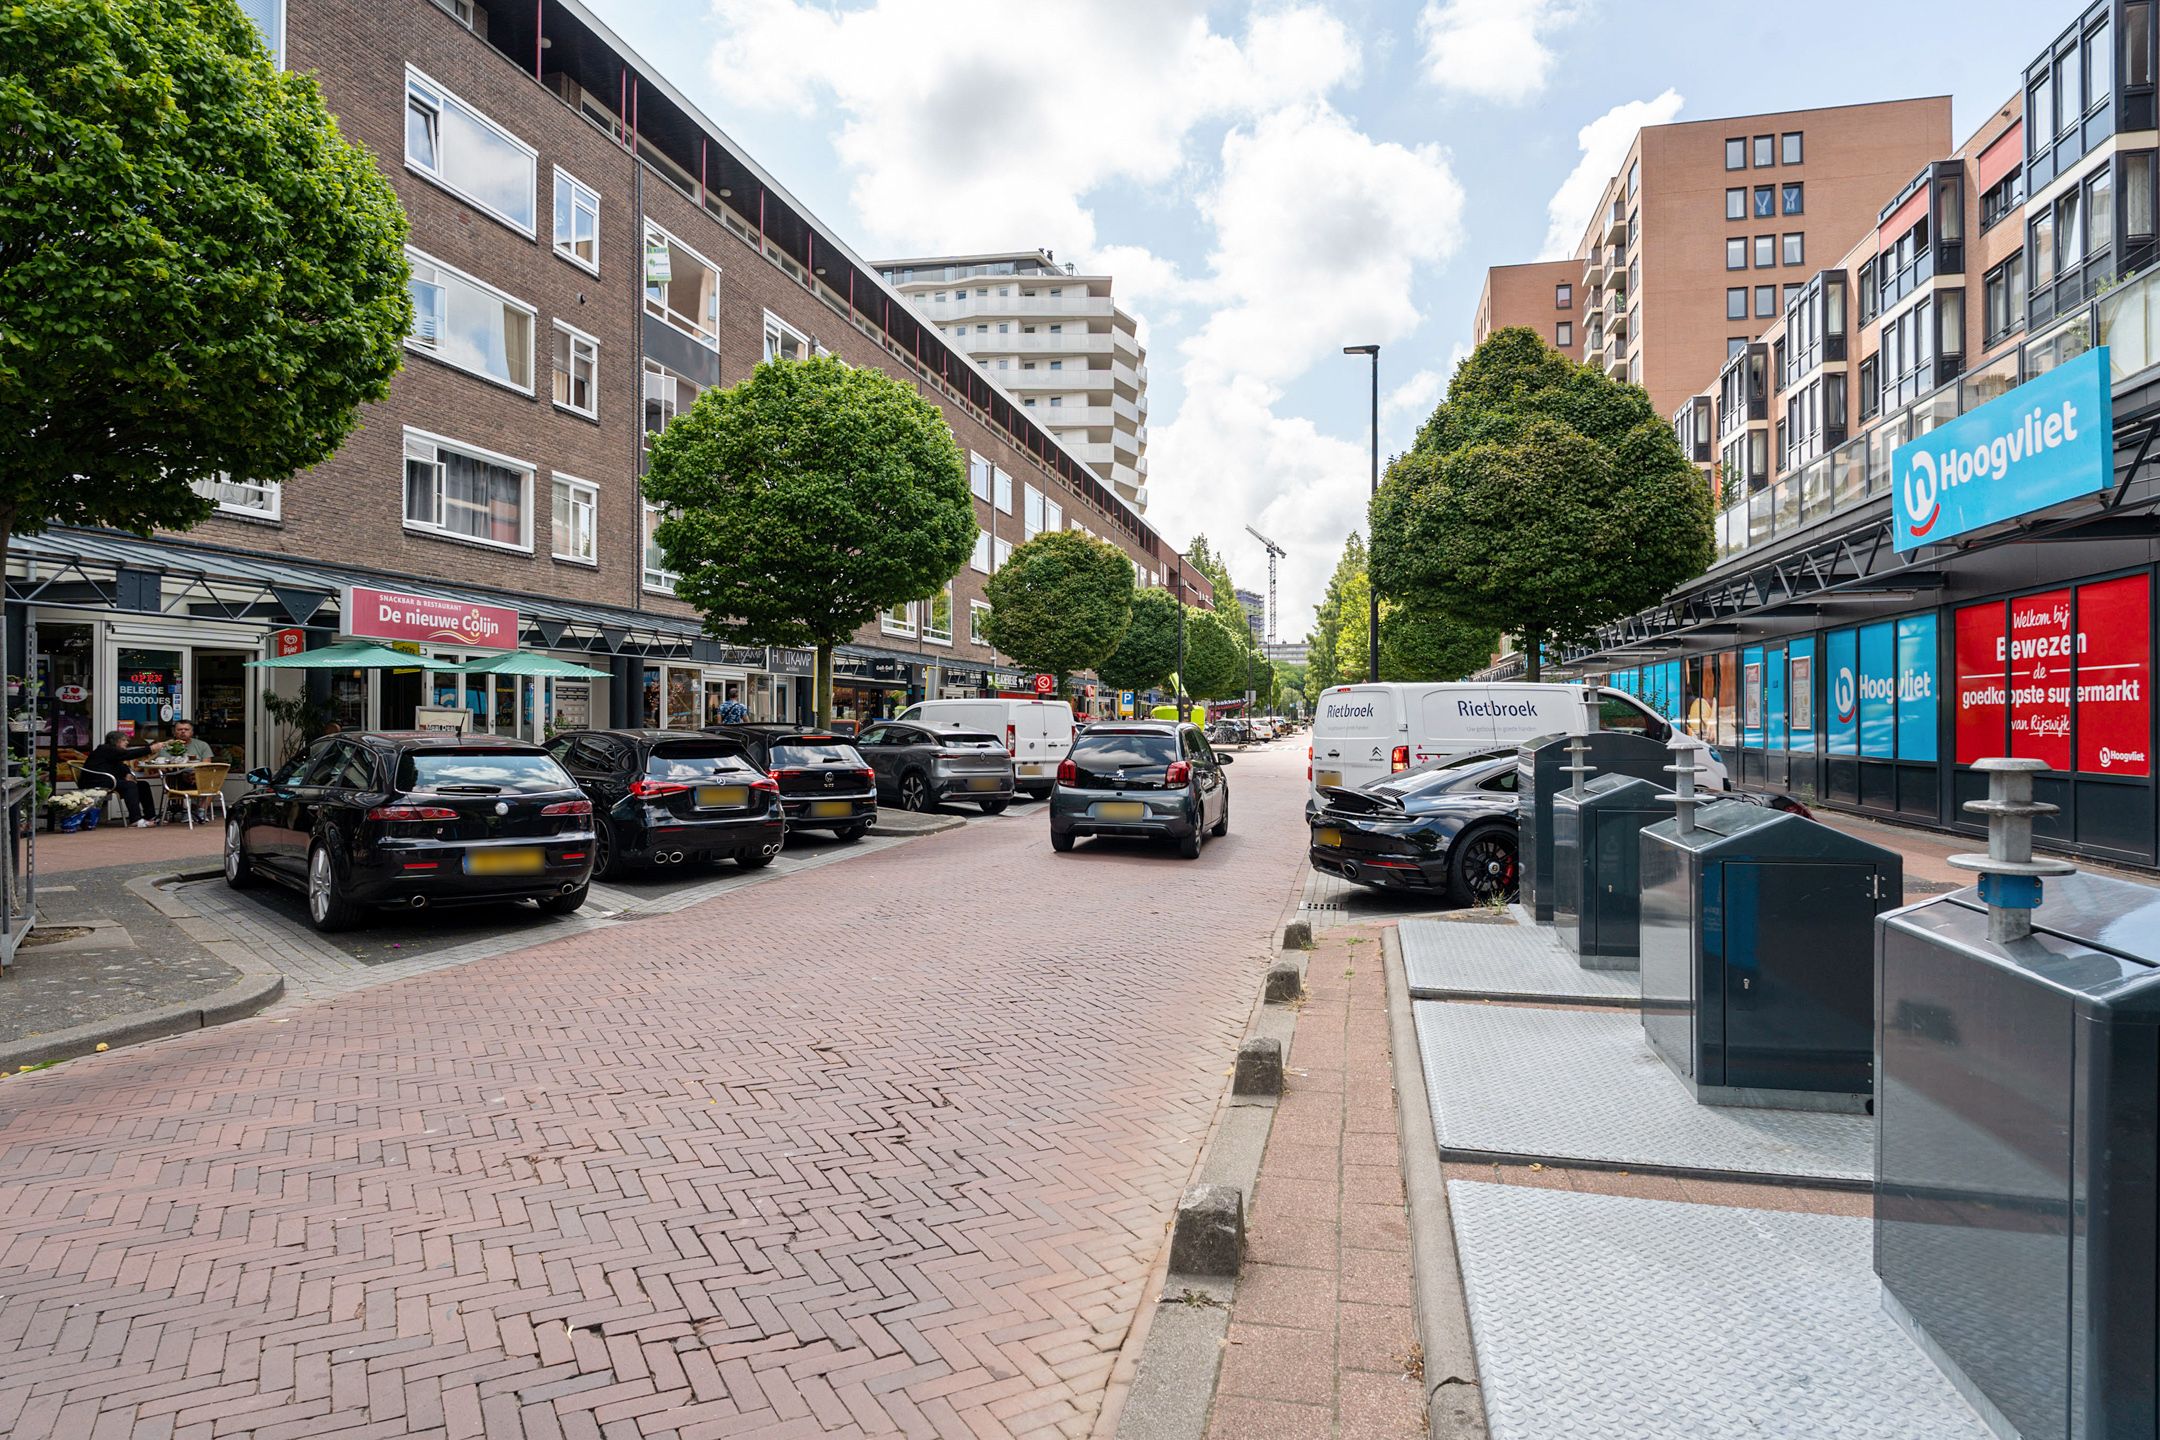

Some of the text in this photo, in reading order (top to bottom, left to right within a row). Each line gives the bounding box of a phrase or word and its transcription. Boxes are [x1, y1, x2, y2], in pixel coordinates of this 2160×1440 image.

[1940, 400, 2078, 491] Hoogvliet
[379, 594, 415, 606] SNACKBAR
[423, 600, 462, 612] RESTAURANT
[379, 604, 499, 637] De nieuwe Colijn
[2013, 603, 2070, 631] Welkom bij
[1996, 632, 2087, 662] Bewezen
[130, 672, 163, 684] OPEN
[2032, 661, 2047, 680] de
[119, 685, 164, 695] BELEGDE
[1859, 668, 1932, 704] Hoogvliet
[2047, 679, 2140, 708] supermarkt
[119, 695, 171, 705] BROODJES
[1124, 693, 1132, 704] P
[1327, 702, 1374, 719] Rietbroek
[1457, 700, 1538, 717] Rietbroek
[2010, 714, 2070, 738] van Rijswijk
[2110, 750, 2145, 763] Hoogvliet
